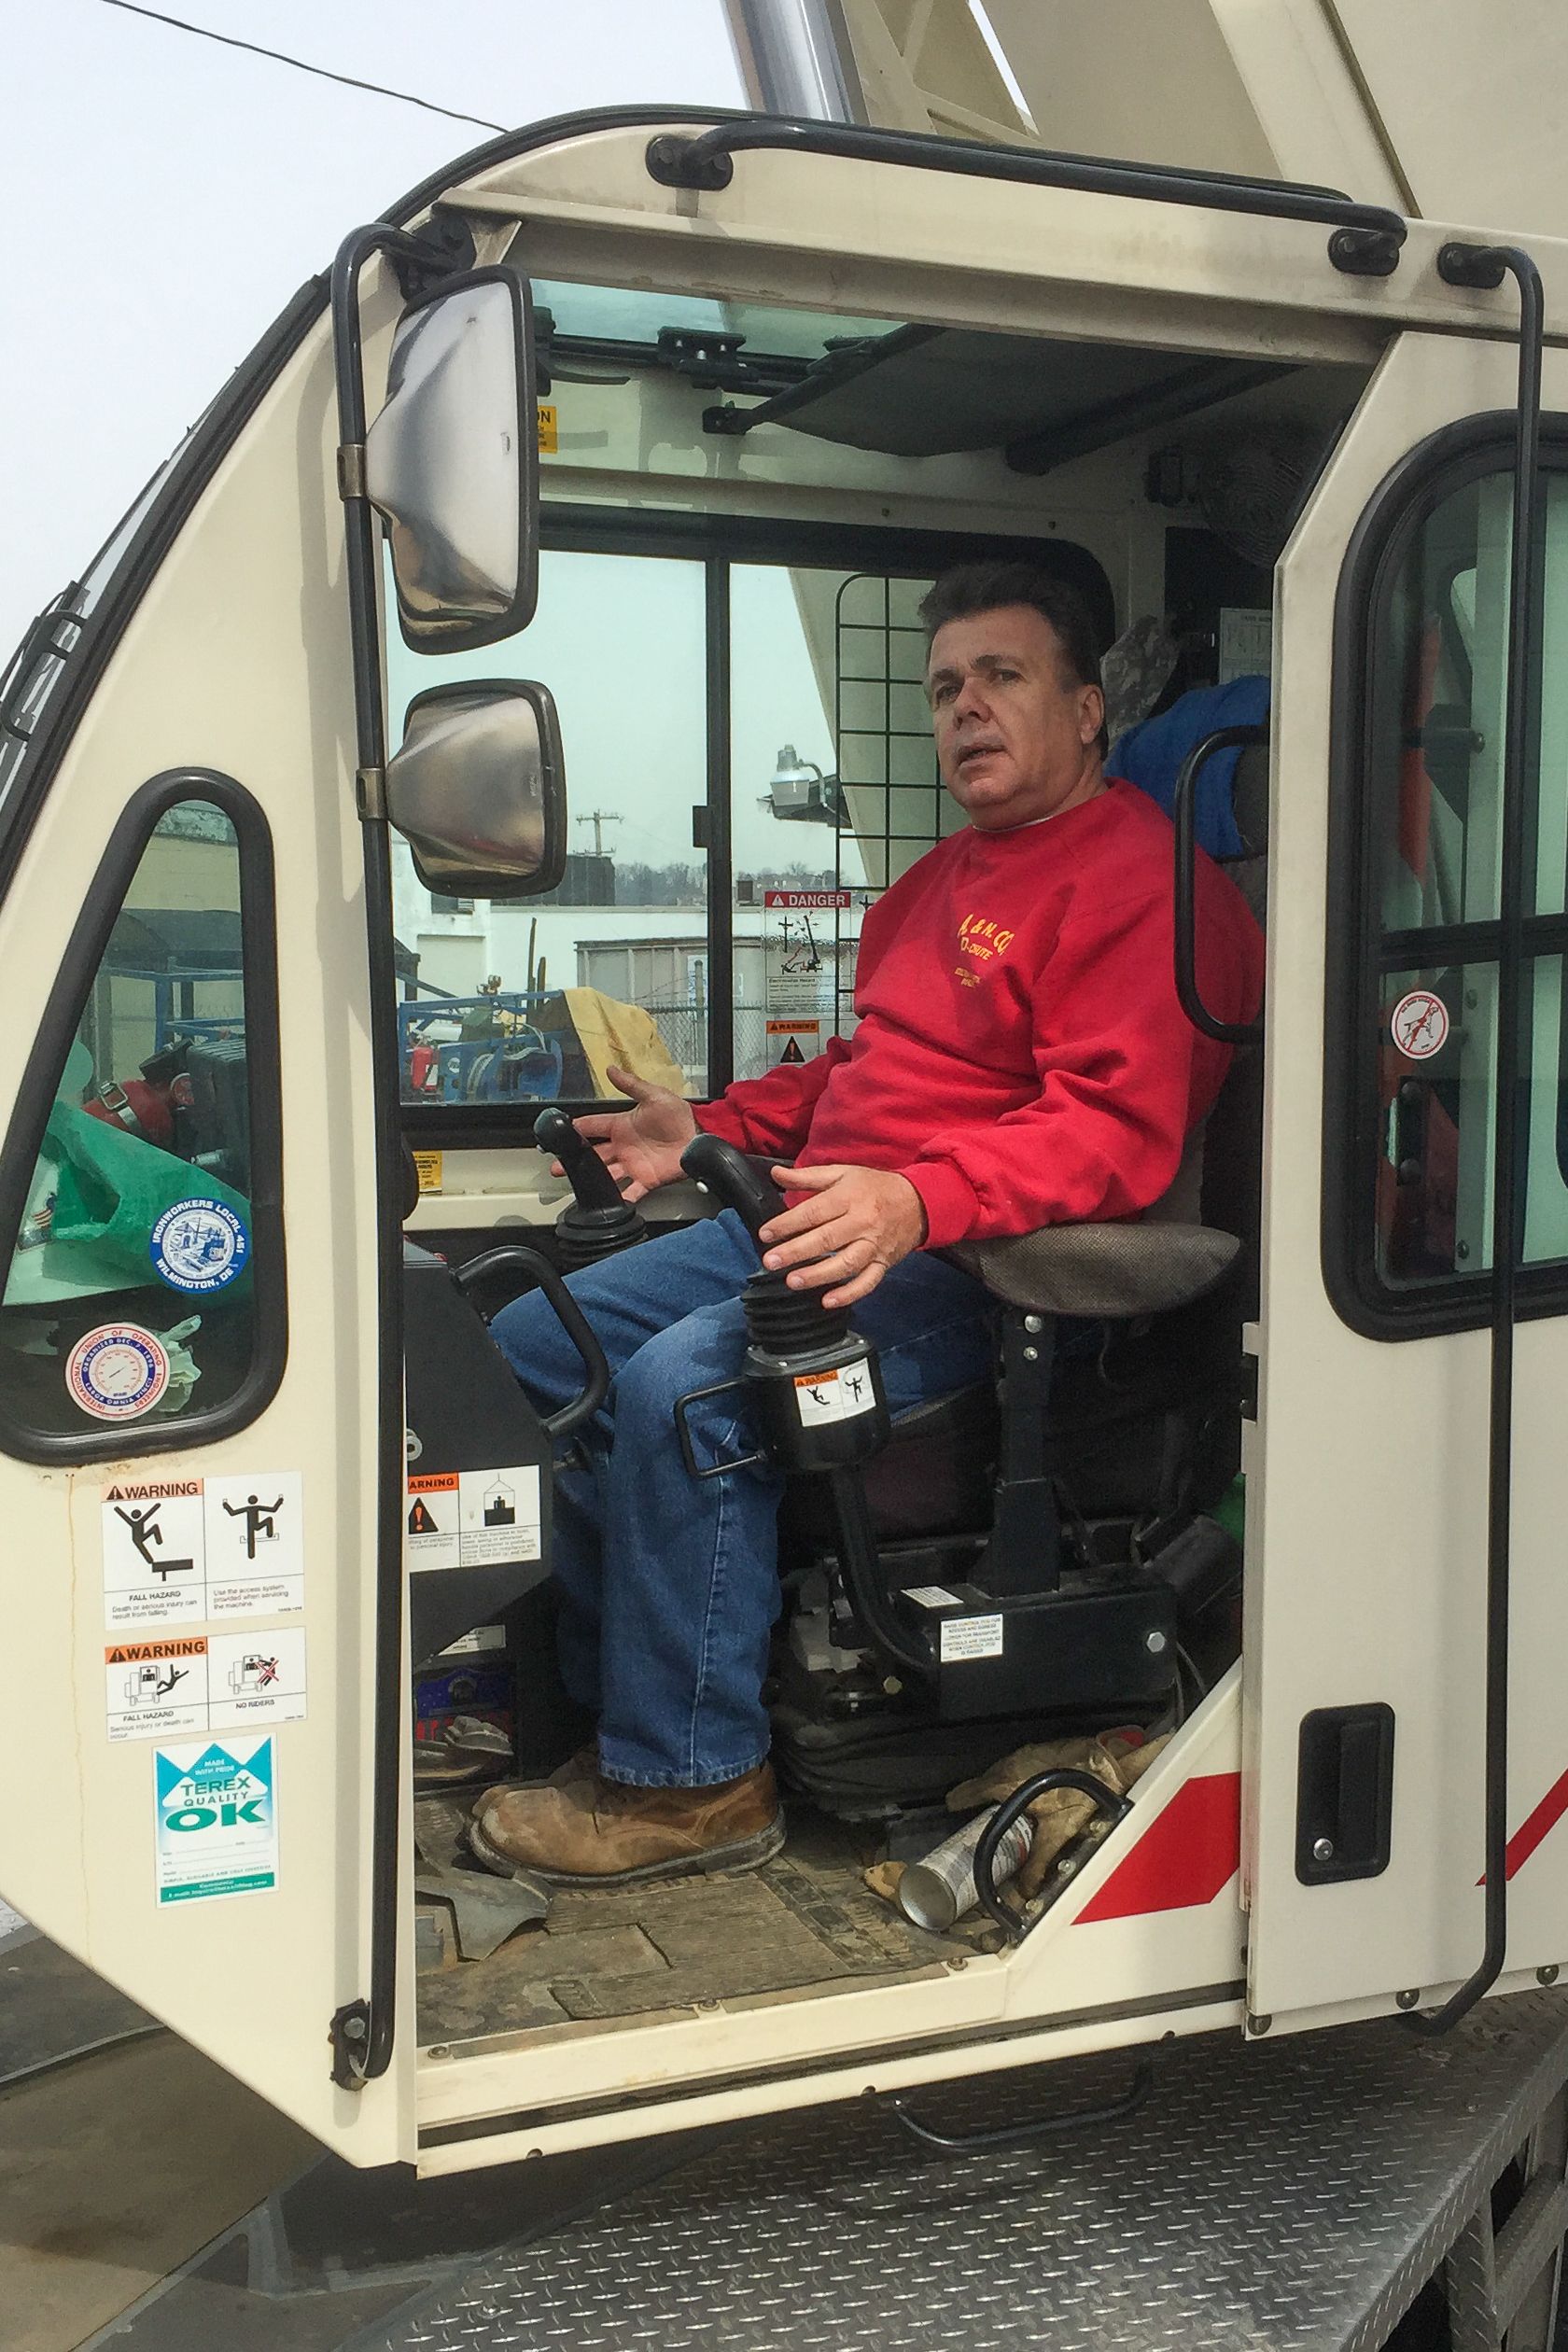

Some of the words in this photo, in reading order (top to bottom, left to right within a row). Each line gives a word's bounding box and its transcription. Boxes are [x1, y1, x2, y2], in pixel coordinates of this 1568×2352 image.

[789, 894, 846, 906] DANGER
[152, 1199, 214, 1243] IRONWORKERS
[215, 1204, 242, 1233] LOCAL
[156, 1258, 219, 1289] WILMINGTON,
[218, 1267, 234, 1281] DE
[81, 1333, 105, 1353] UNION
[132, 1333, 162, 1366] OPERATING
[83, 1338, 114, 1372] ORGANIZED
[74, 1362, 105, 1411] INTERNATIONAL
[85, 1382, 105, 1401] LABOR
[134, 1373, 162, 1407] ENGINEERS
[125, 1482, 198, 1499] WARNING
[149, 1590, 181, 1600] HAZARD
[127, 1641, 205, 1659] WARNING
[143, 1711, 174, 1719] HAZARD
[180, 1776, 251, 1797] TEREX
[184, 1791, 248, 1807] QUALITY
[165, 1799, 266, 1832] OK
